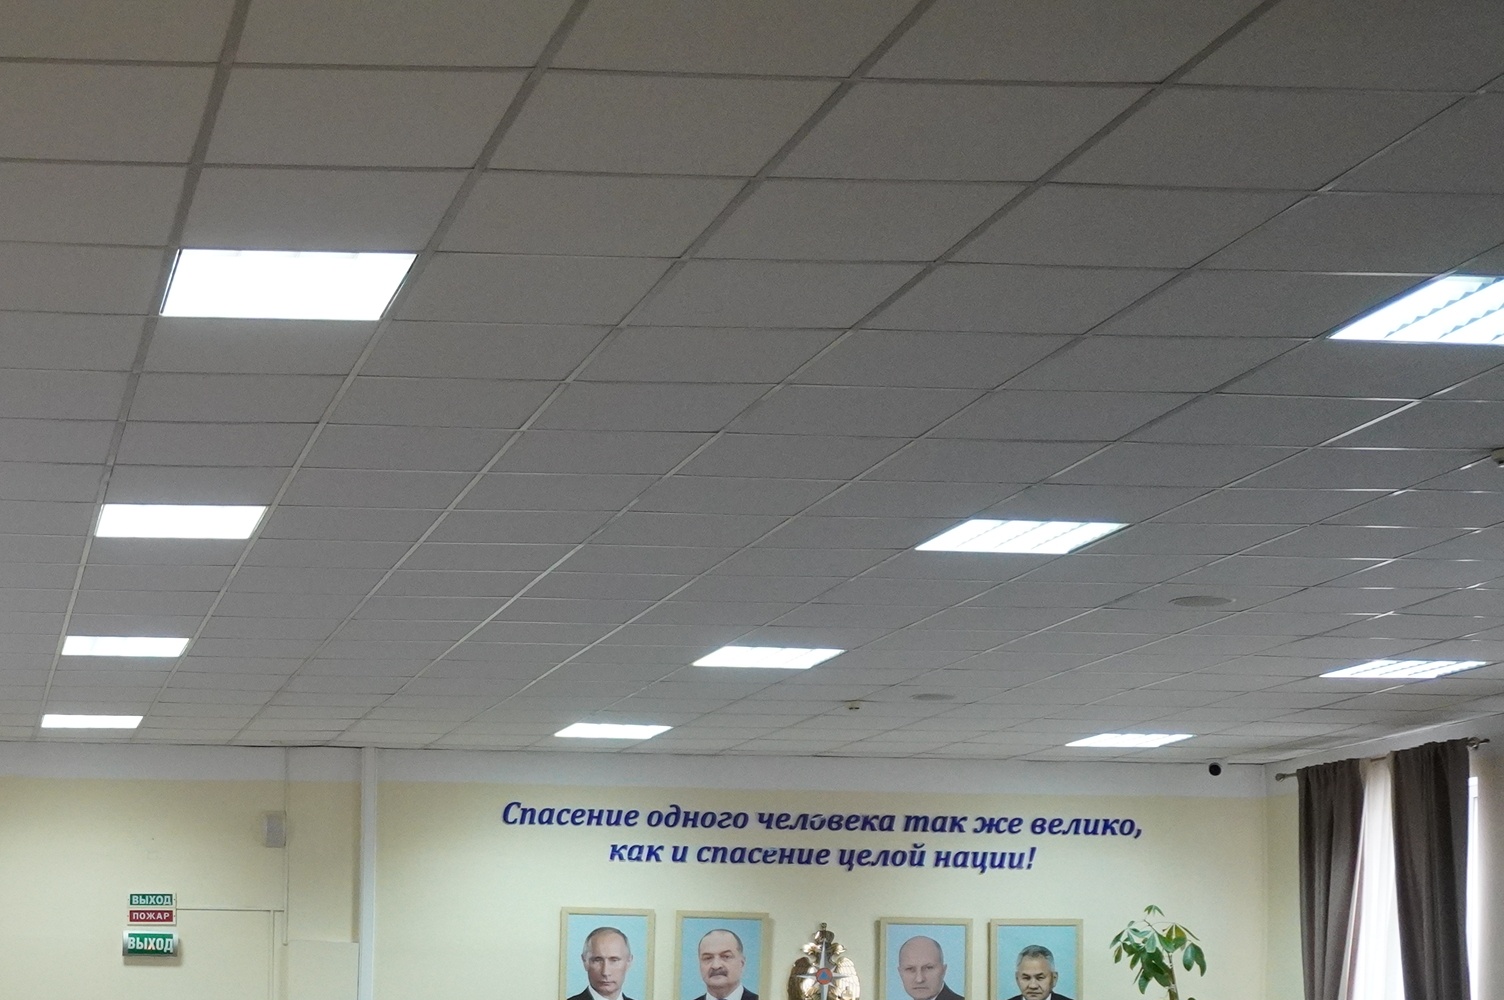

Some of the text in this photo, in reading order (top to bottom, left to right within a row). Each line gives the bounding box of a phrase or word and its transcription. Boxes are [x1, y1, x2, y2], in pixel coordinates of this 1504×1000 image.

[502, 801, 1143, 840] Спасение одного человека так же велико,
[609, 843, 1037, 875] как и спасение целой нации!
[131, 895, 172, 905] ВЫХОД
[132, 912, 170, 920] ПОЖАР
[127, 936, 174, 953] ВЫХОД
